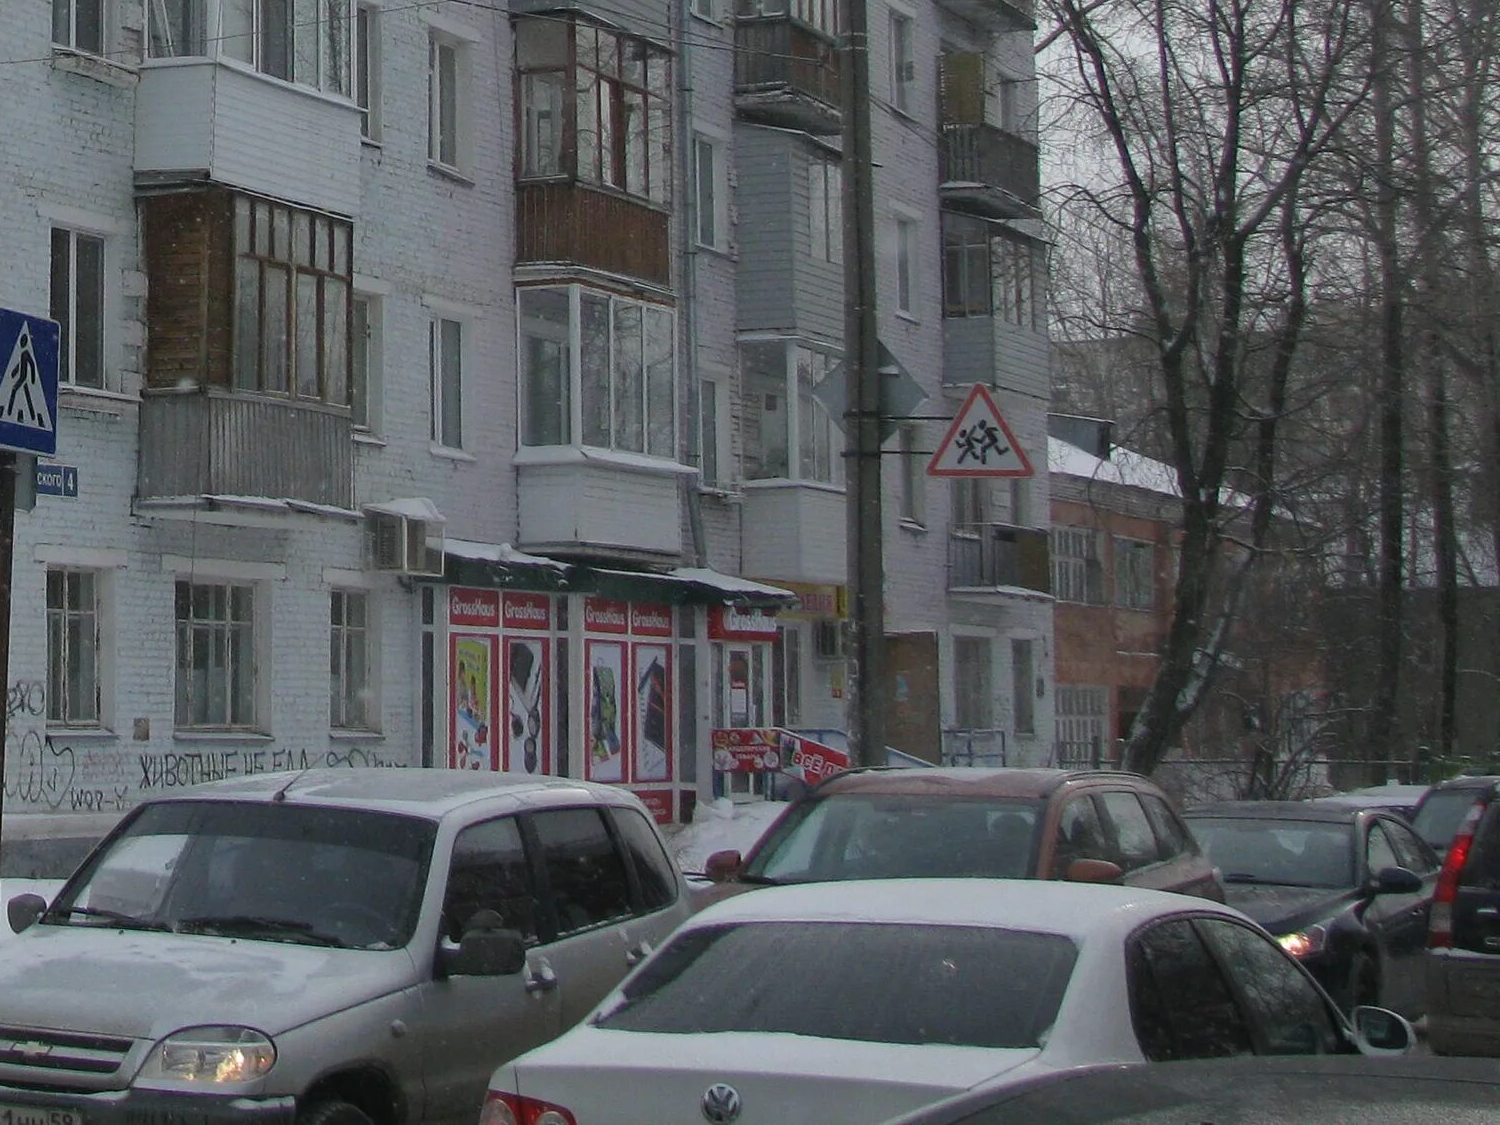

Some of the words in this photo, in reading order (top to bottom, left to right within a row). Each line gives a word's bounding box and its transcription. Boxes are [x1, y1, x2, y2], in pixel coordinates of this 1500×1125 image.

[67, 472, 74, 491] 4
[451, 595, 496, 618] GrossHaus
[504, 600, 546, 620] GrossHaus
[585, 605, 626, 626] GrossHaus
[632, 610, 669, 629] GrossHaus
[139, 750, 238, 789] ЖИВОТНЫЕ
